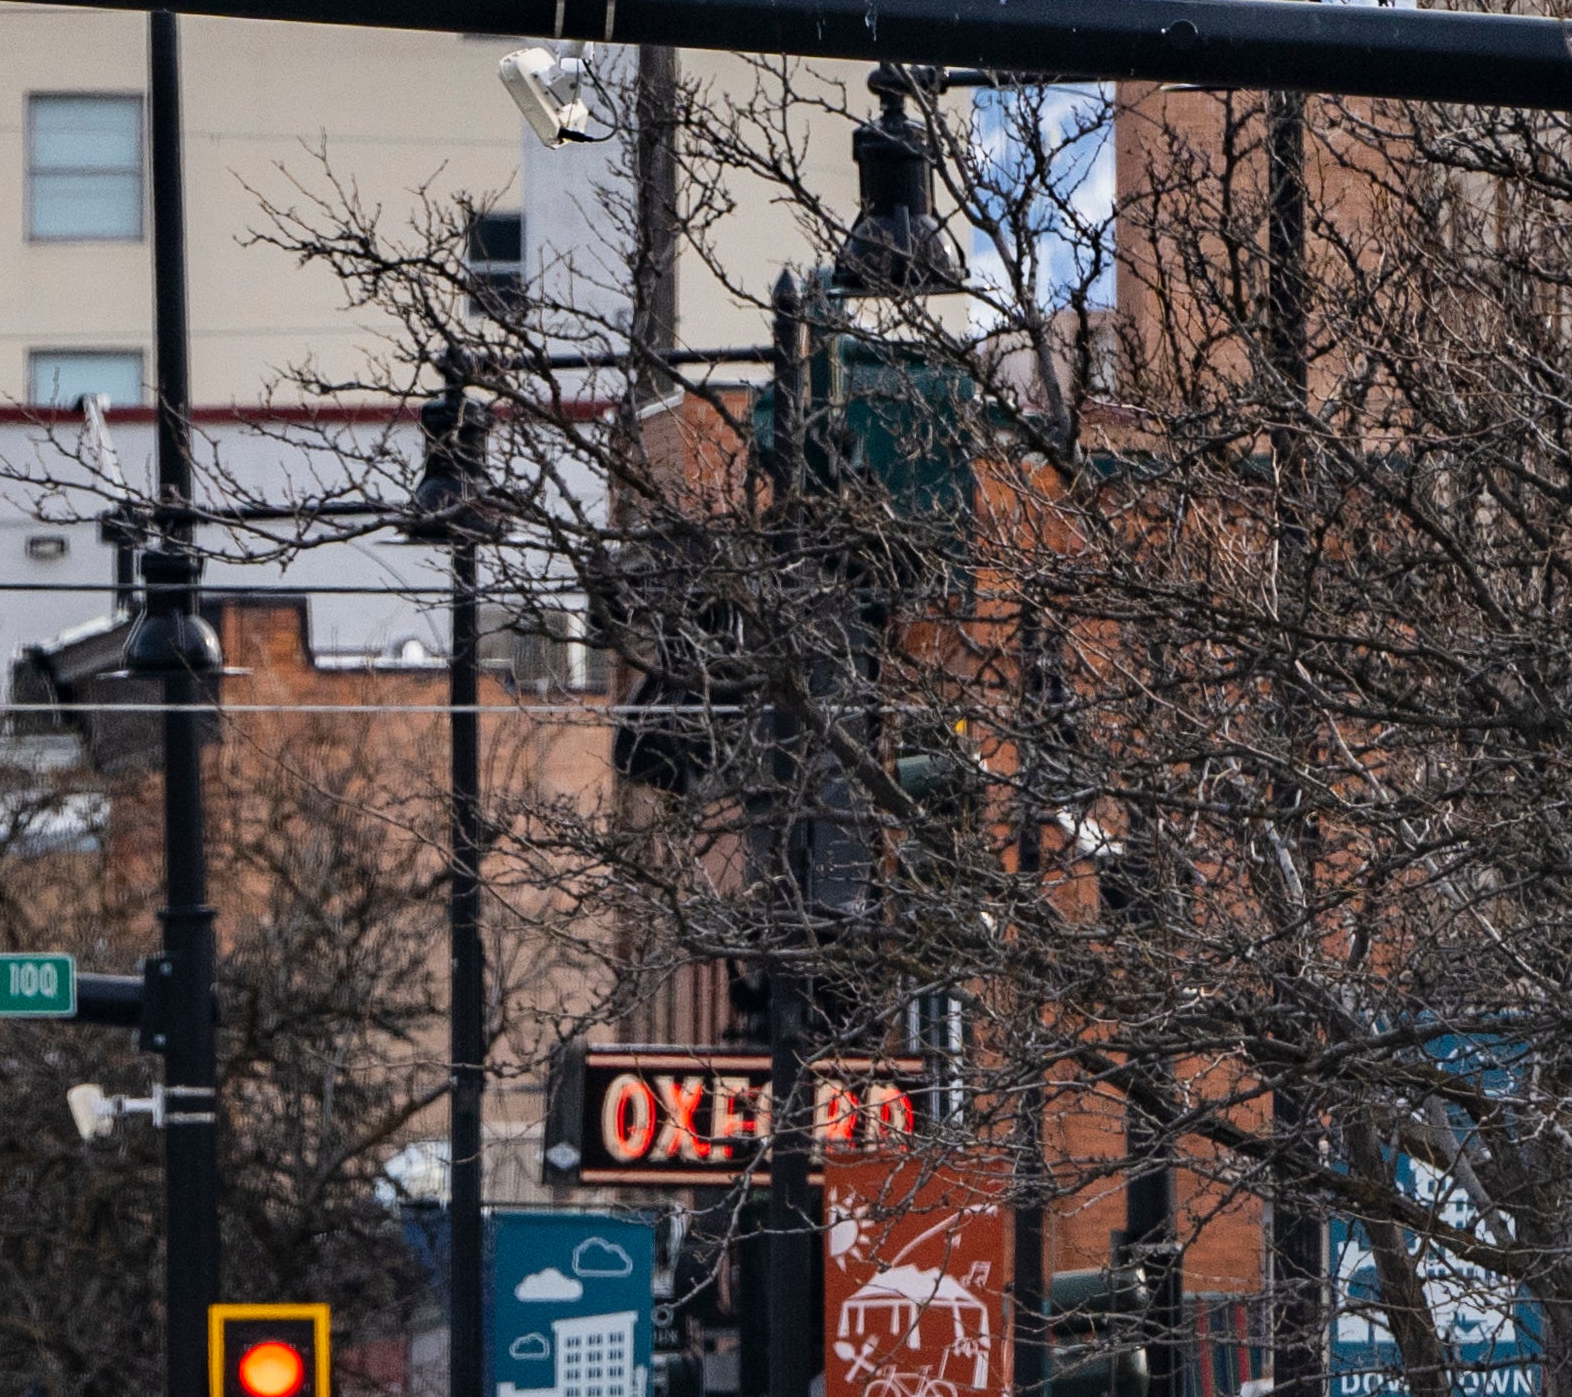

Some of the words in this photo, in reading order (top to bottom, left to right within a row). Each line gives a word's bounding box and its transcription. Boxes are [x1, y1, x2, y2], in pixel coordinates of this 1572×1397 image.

[8, 961, 59, 999] 100
[601, 1072, 916, 1164] OXFRD
[1340, 1369, 1533, 1395] DOWOWN
